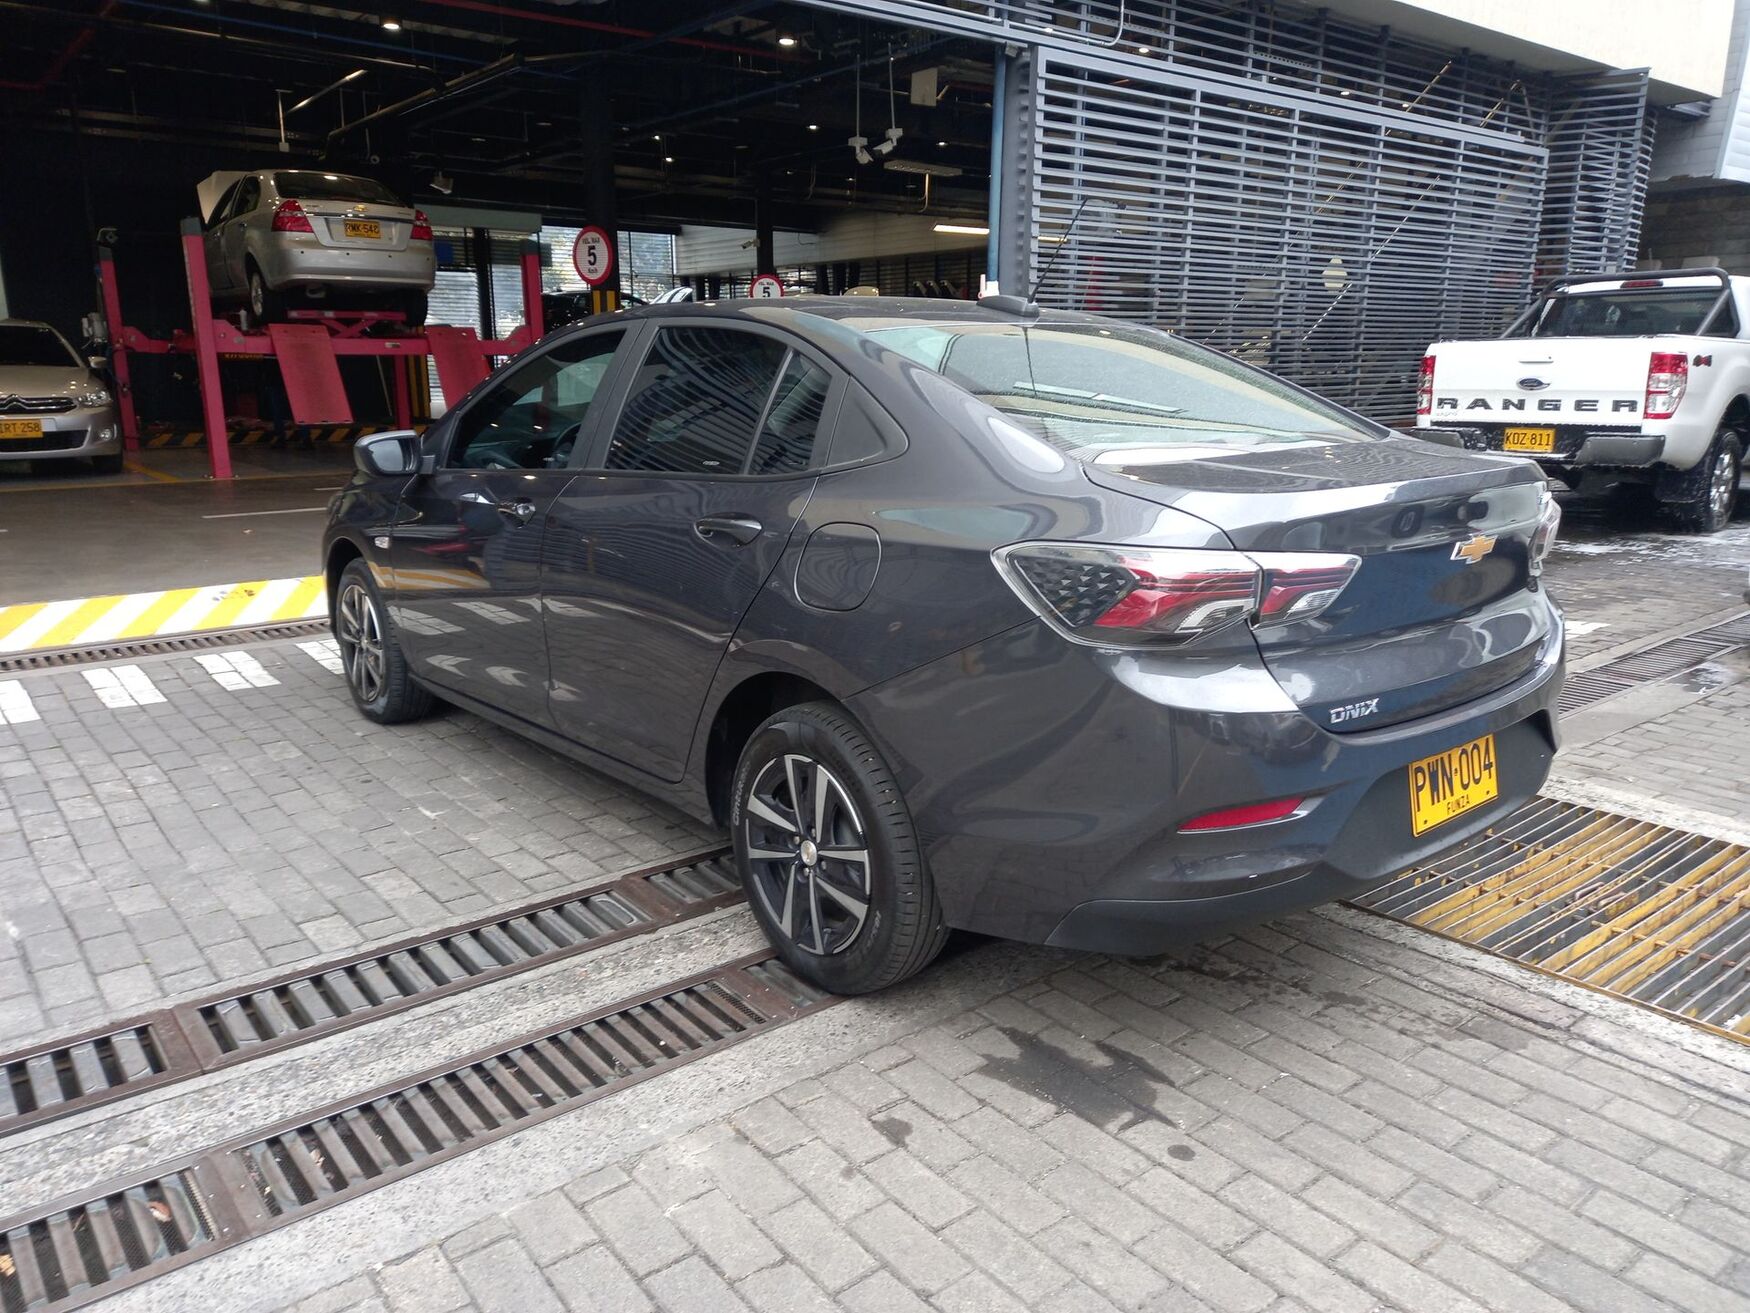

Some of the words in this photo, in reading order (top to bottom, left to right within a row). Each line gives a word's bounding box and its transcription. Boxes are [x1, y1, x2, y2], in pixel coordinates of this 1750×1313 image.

[587, 245, 597, 266] 5
[762, 286, 771, 297] 5
[1436, 397, 1639, 412] RANGER
[1330, 697, 1380, 724] ONIX
[1446, 793, 1471, 816] FUNZA
